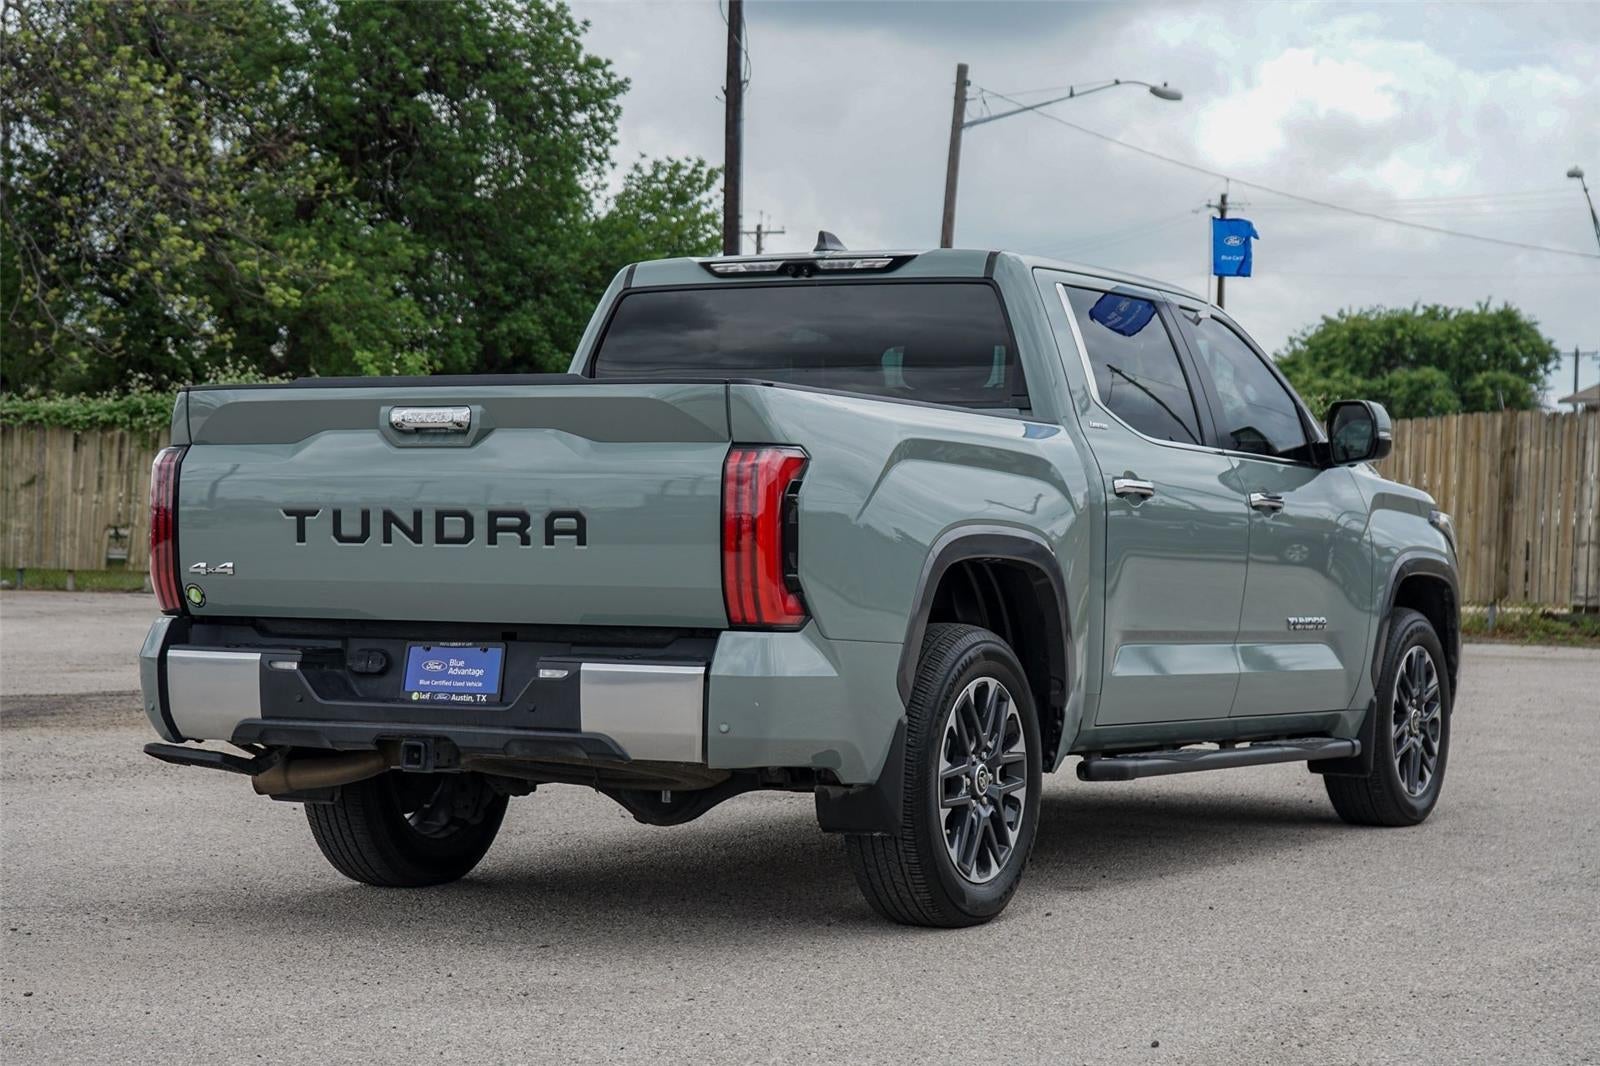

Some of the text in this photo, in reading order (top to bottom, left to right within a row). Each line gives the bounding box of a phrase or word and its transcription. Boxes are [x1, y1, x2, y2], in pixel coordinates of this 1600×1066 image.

[280, 508, 588, 549] TUNDRA
[189, 561, 234, 576] 4x4
[424, 661, 445, 671] Ford
[449, 659, 465, 667] Blue
[448, 668, 484, 677] Advantage
[451, 694, 474, 702] Austin,
[476, 694, 487, 702] TX
